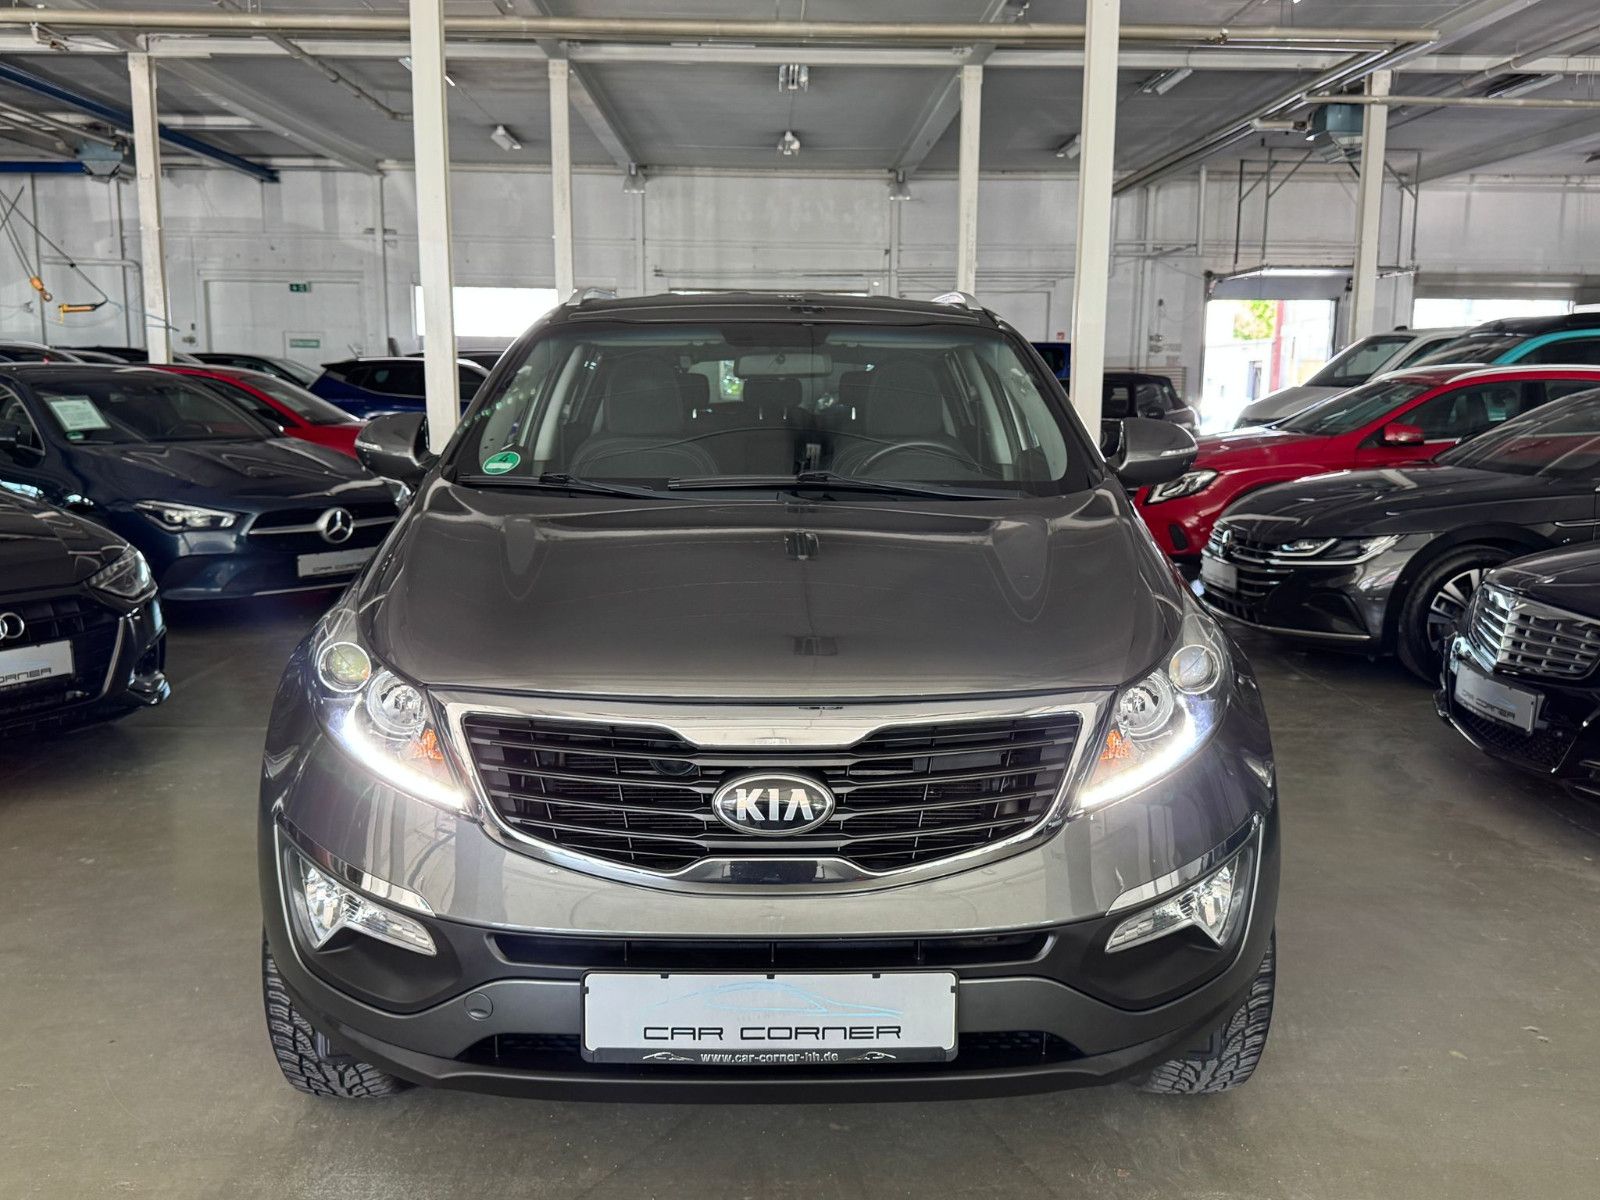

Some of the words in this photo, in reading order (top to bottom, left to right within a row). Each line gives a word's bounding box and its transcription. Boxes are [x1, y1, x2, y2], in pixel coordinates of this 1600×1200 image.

[735, 788, 815, 821] KIA
[643, 1026, 724, 1041] CAR
[740, 1025, 902, 1041] CORNER
[700, 1051, 839, 1064] www.car-corner-hh.de
